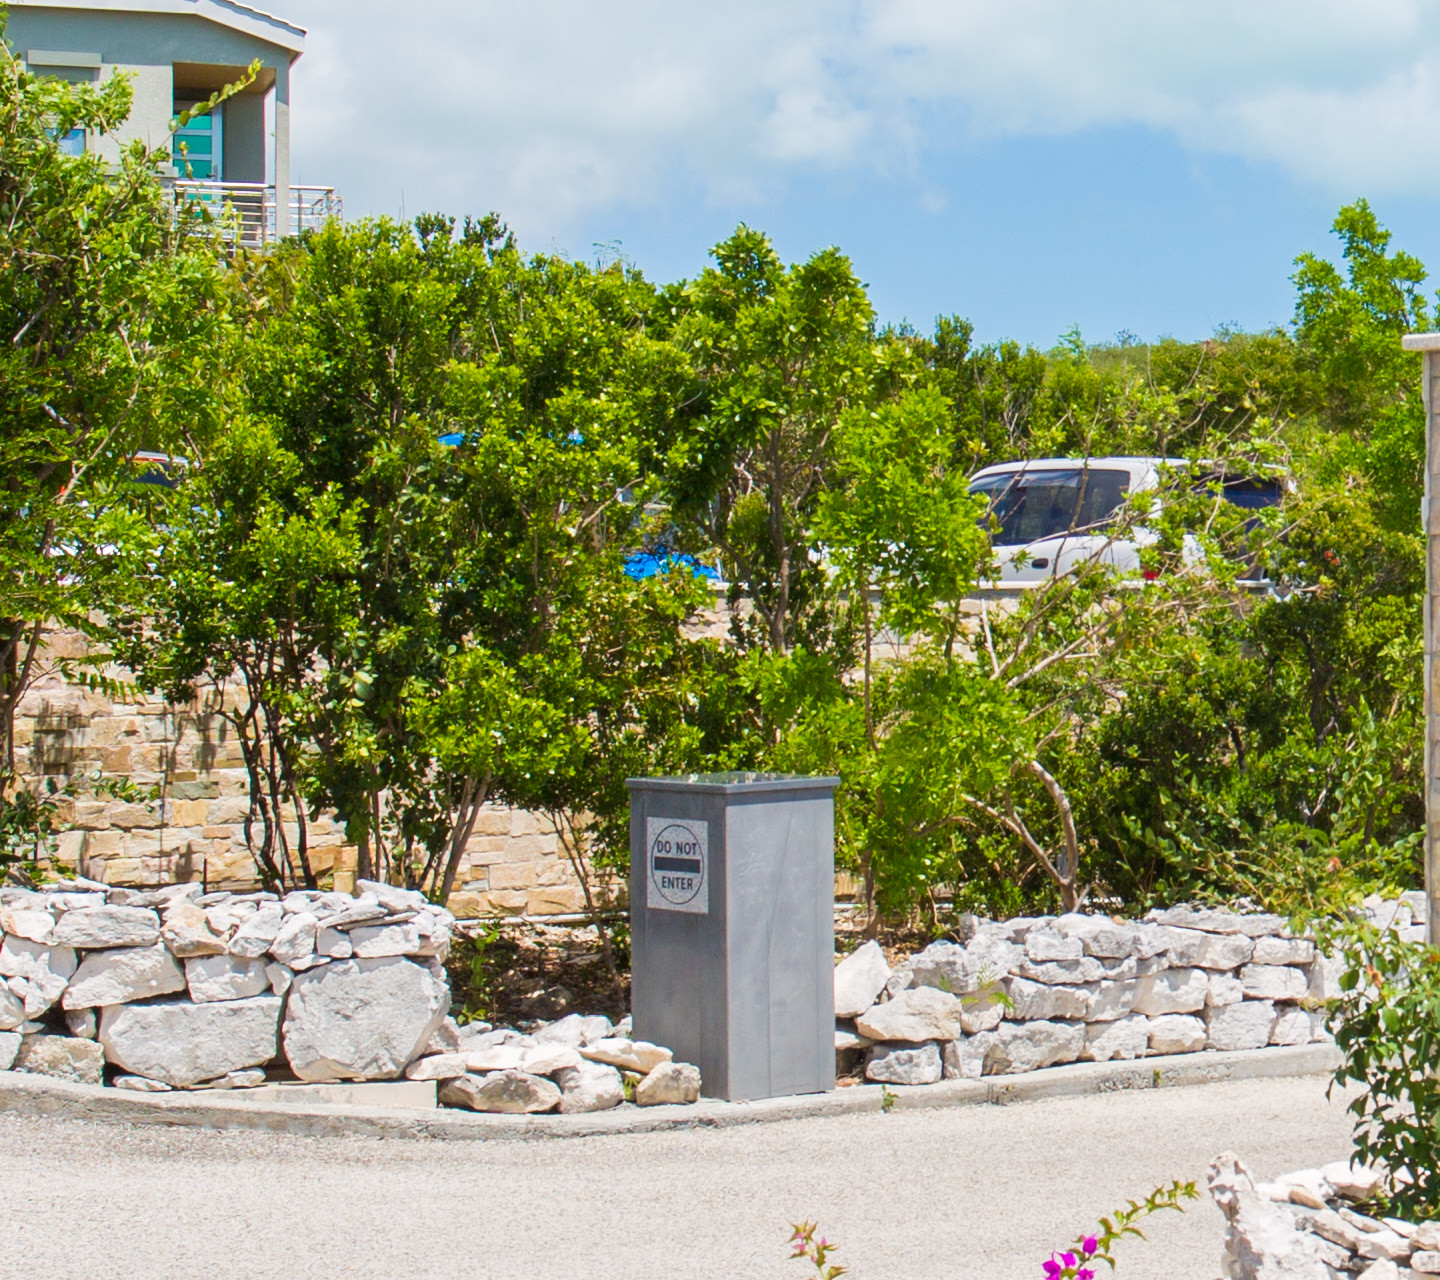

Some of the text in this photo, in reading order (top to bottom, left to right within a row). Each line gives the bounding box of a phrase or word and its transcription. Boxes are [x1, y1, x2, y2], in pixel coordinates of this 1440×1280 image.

[657, 840, 696, 855] DO NOT
[662, 876, 693, 890] ENTER
